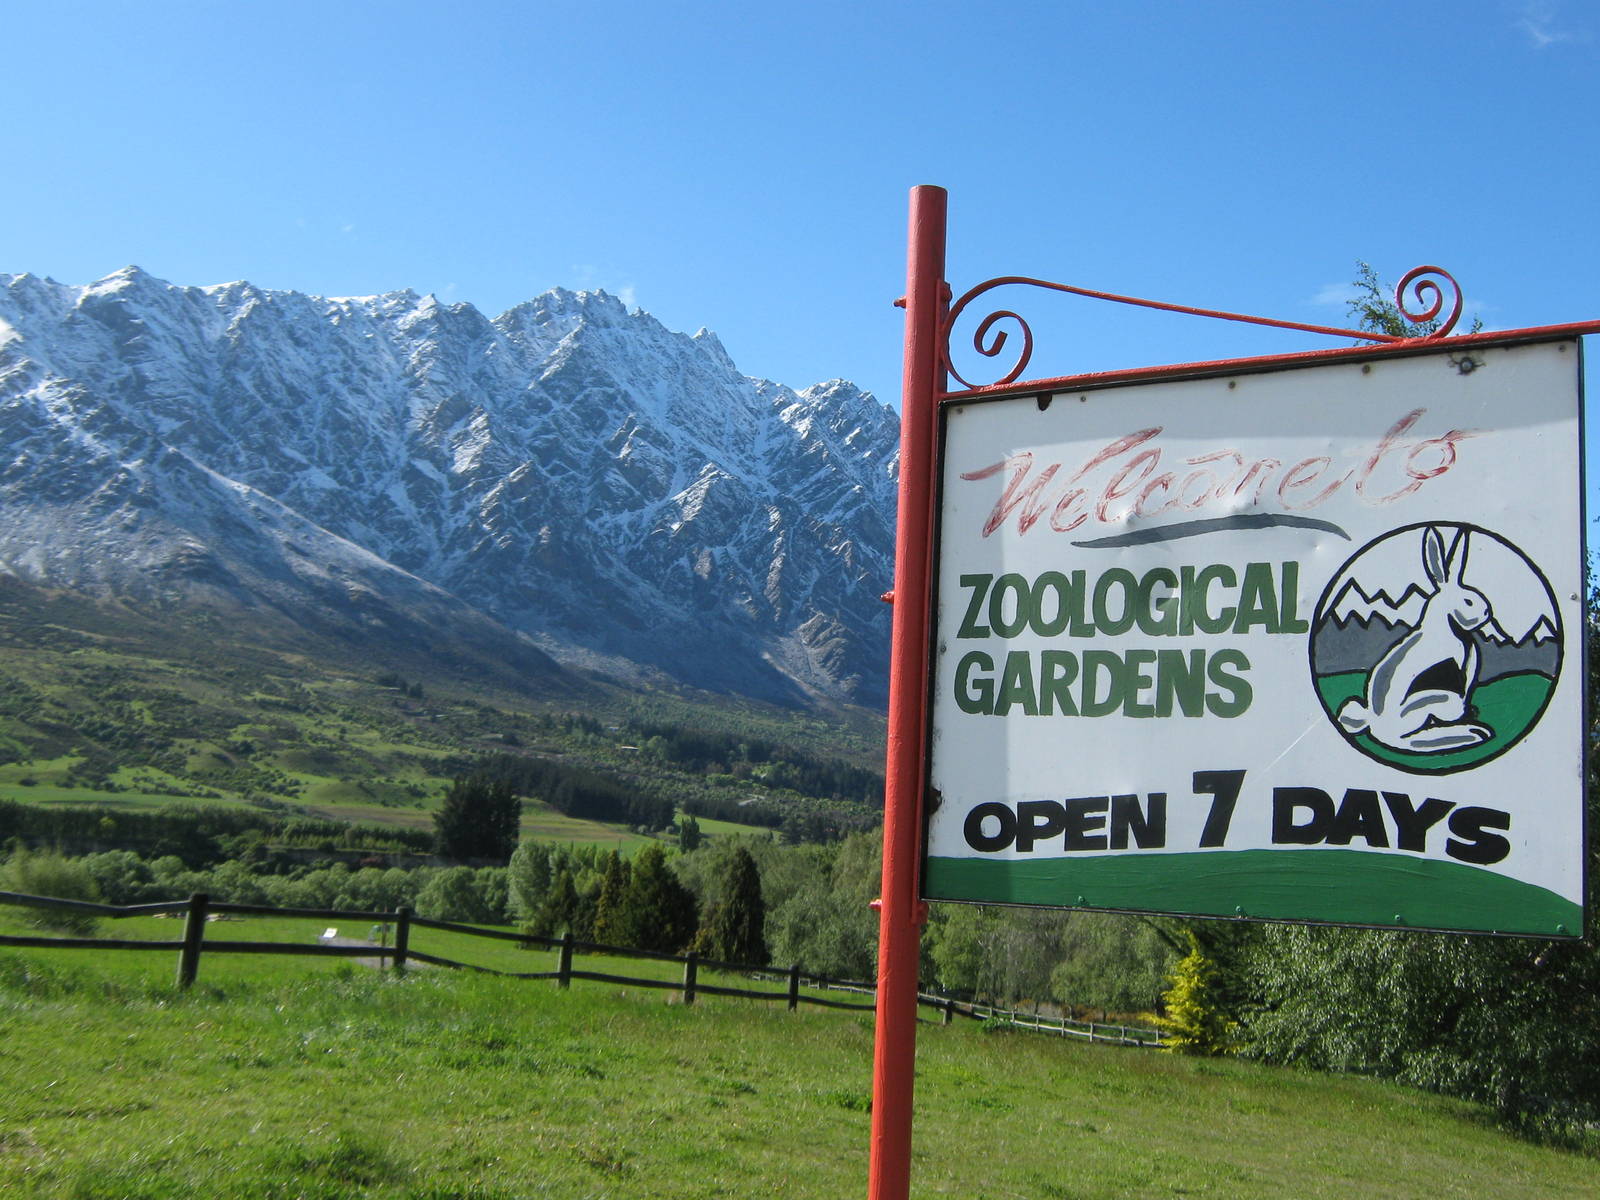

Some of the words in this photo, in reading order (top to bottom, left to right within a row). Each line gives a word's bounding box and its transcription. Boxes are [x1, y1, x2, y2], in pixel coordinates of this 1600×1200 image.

[960, 425, 1354, 538] Welcome
[1354, 407, 1476, 508] to
[957, 561, 1309, 639] ZOOLOGICAL
[954, 648, 1253, 718] GARDENS
[963, 792, 1167, 853] OPEN
[1192, 769, 1247, 847] 7
[1271, 786, 1510, 865] DAYS
